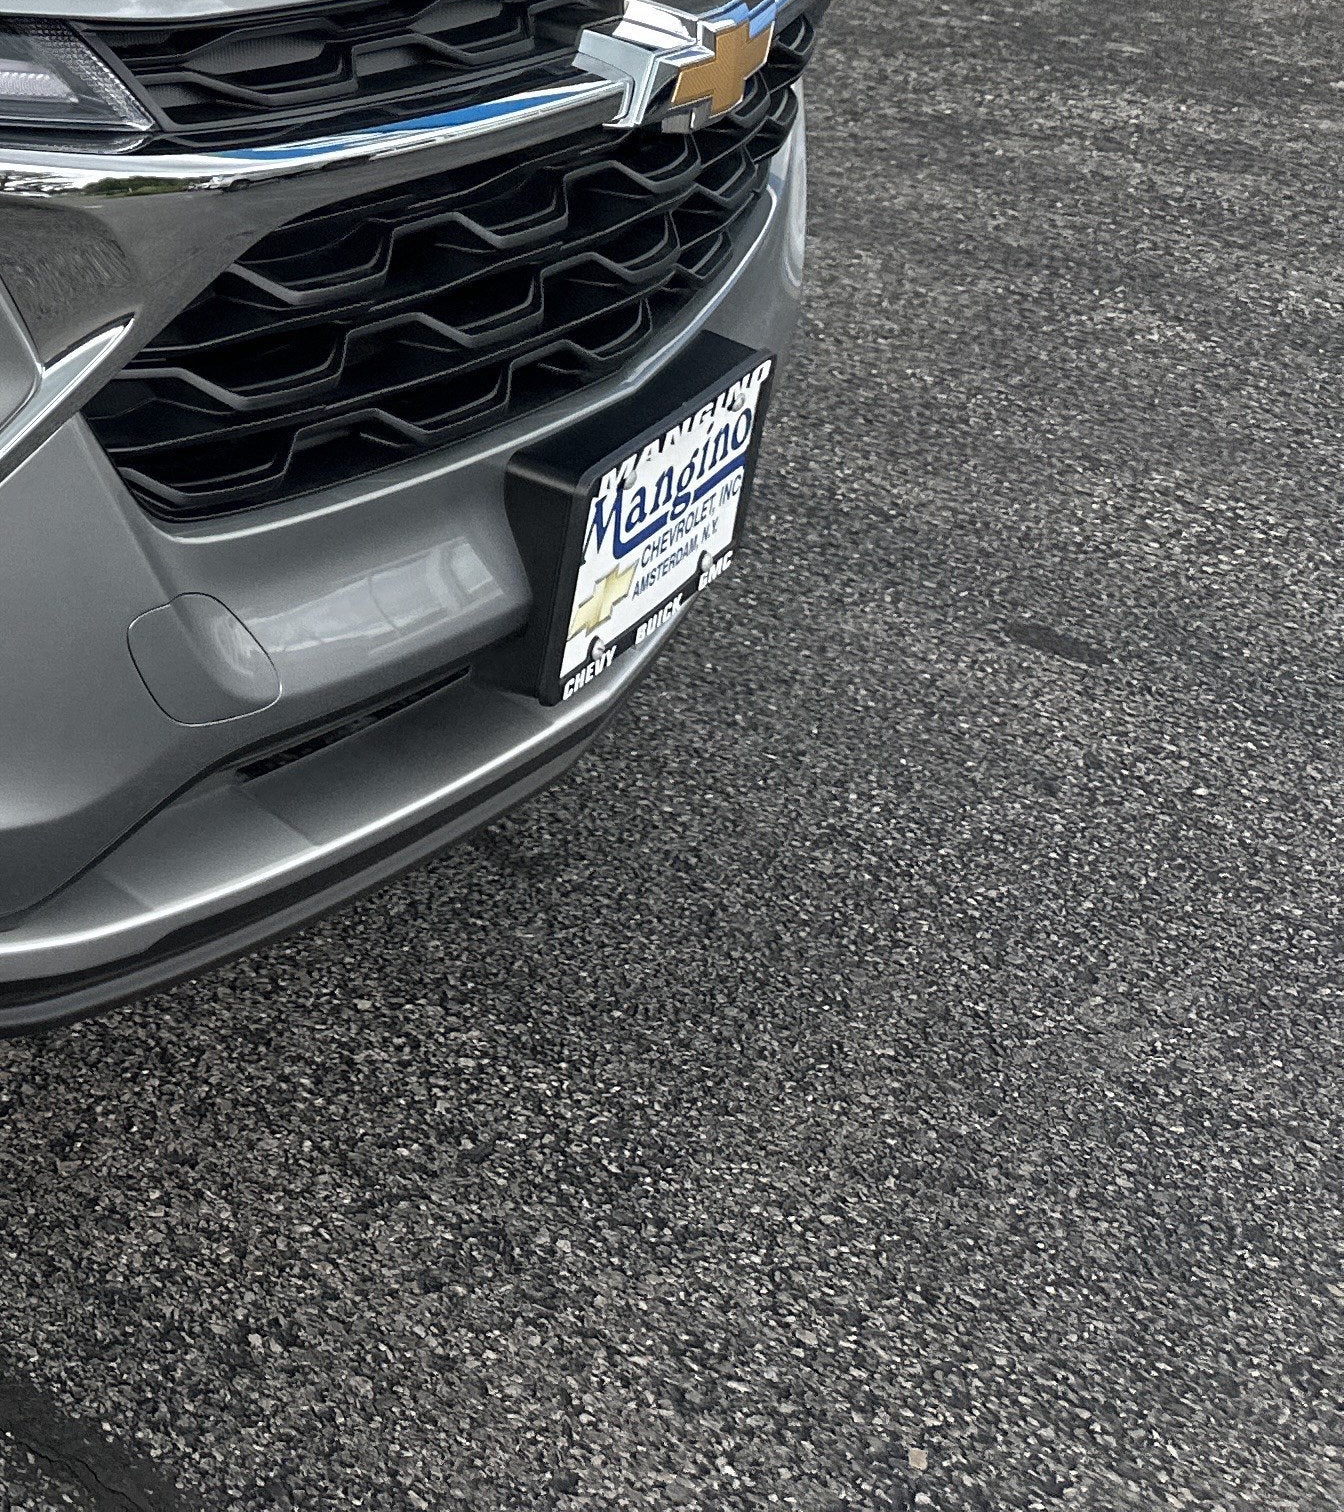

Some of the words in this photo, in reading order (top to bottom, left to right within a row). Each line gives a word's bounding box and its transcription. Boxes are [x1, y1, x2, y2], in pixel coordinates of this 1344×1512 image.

[584, 407, 753, 559] Mangino
[562, 644, 618, 701] CHEVY
[634, 592, 683, 646] BUICK
[697, 550, 734, 592] GMC
